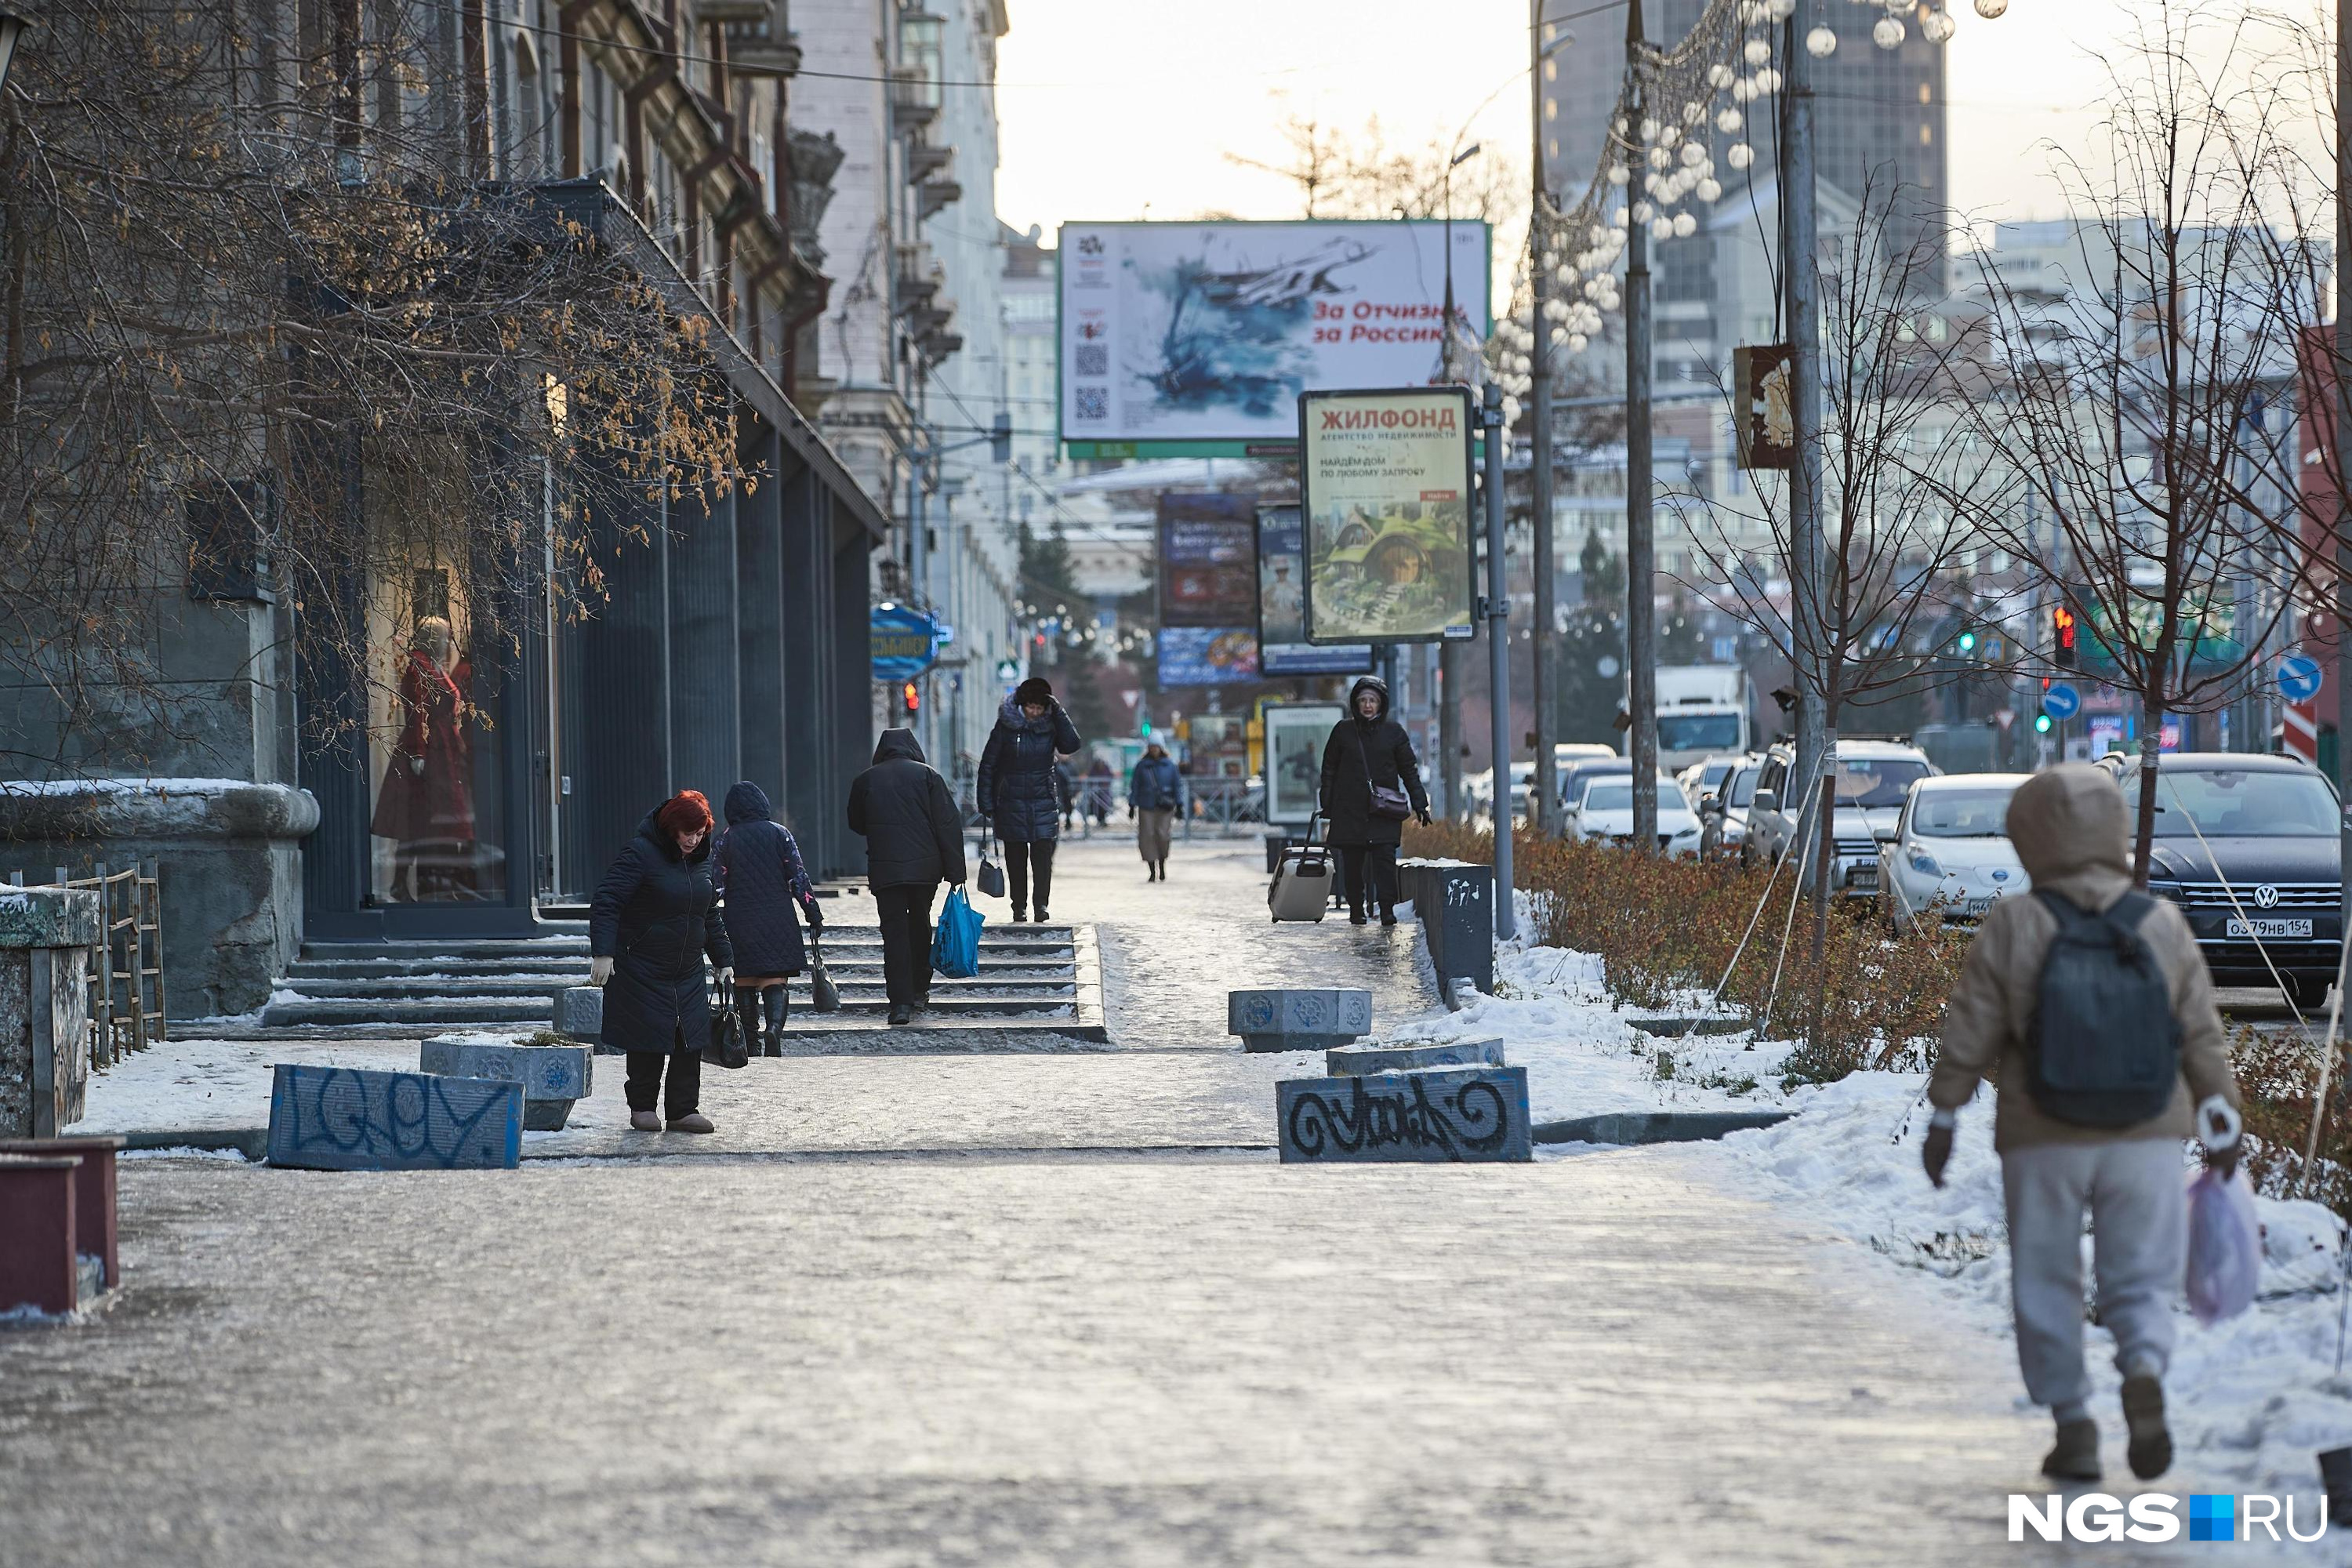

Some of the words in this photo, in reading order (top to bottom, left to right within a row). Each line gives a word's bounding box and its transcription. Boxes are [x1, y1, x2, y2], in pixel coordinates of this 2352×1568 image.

[1313, 301, 1345, 320] За
[1313, 328, 1343, 343] за
[1321, 408, 1457, 431] ЖИЛФОНД
[1320, 433, 1374, 441] АГЕНТСТВО
[1378, 430, 1457, 441] НЕДВИЖИМОСТИ
[1363, 456, 1386, 467] ДОМ
[1320, 470, 1335, 479] ПО
[1337, 468, 1379, 478] ЛЮБОМУ
[2288, 920, 2308, 931] 154
